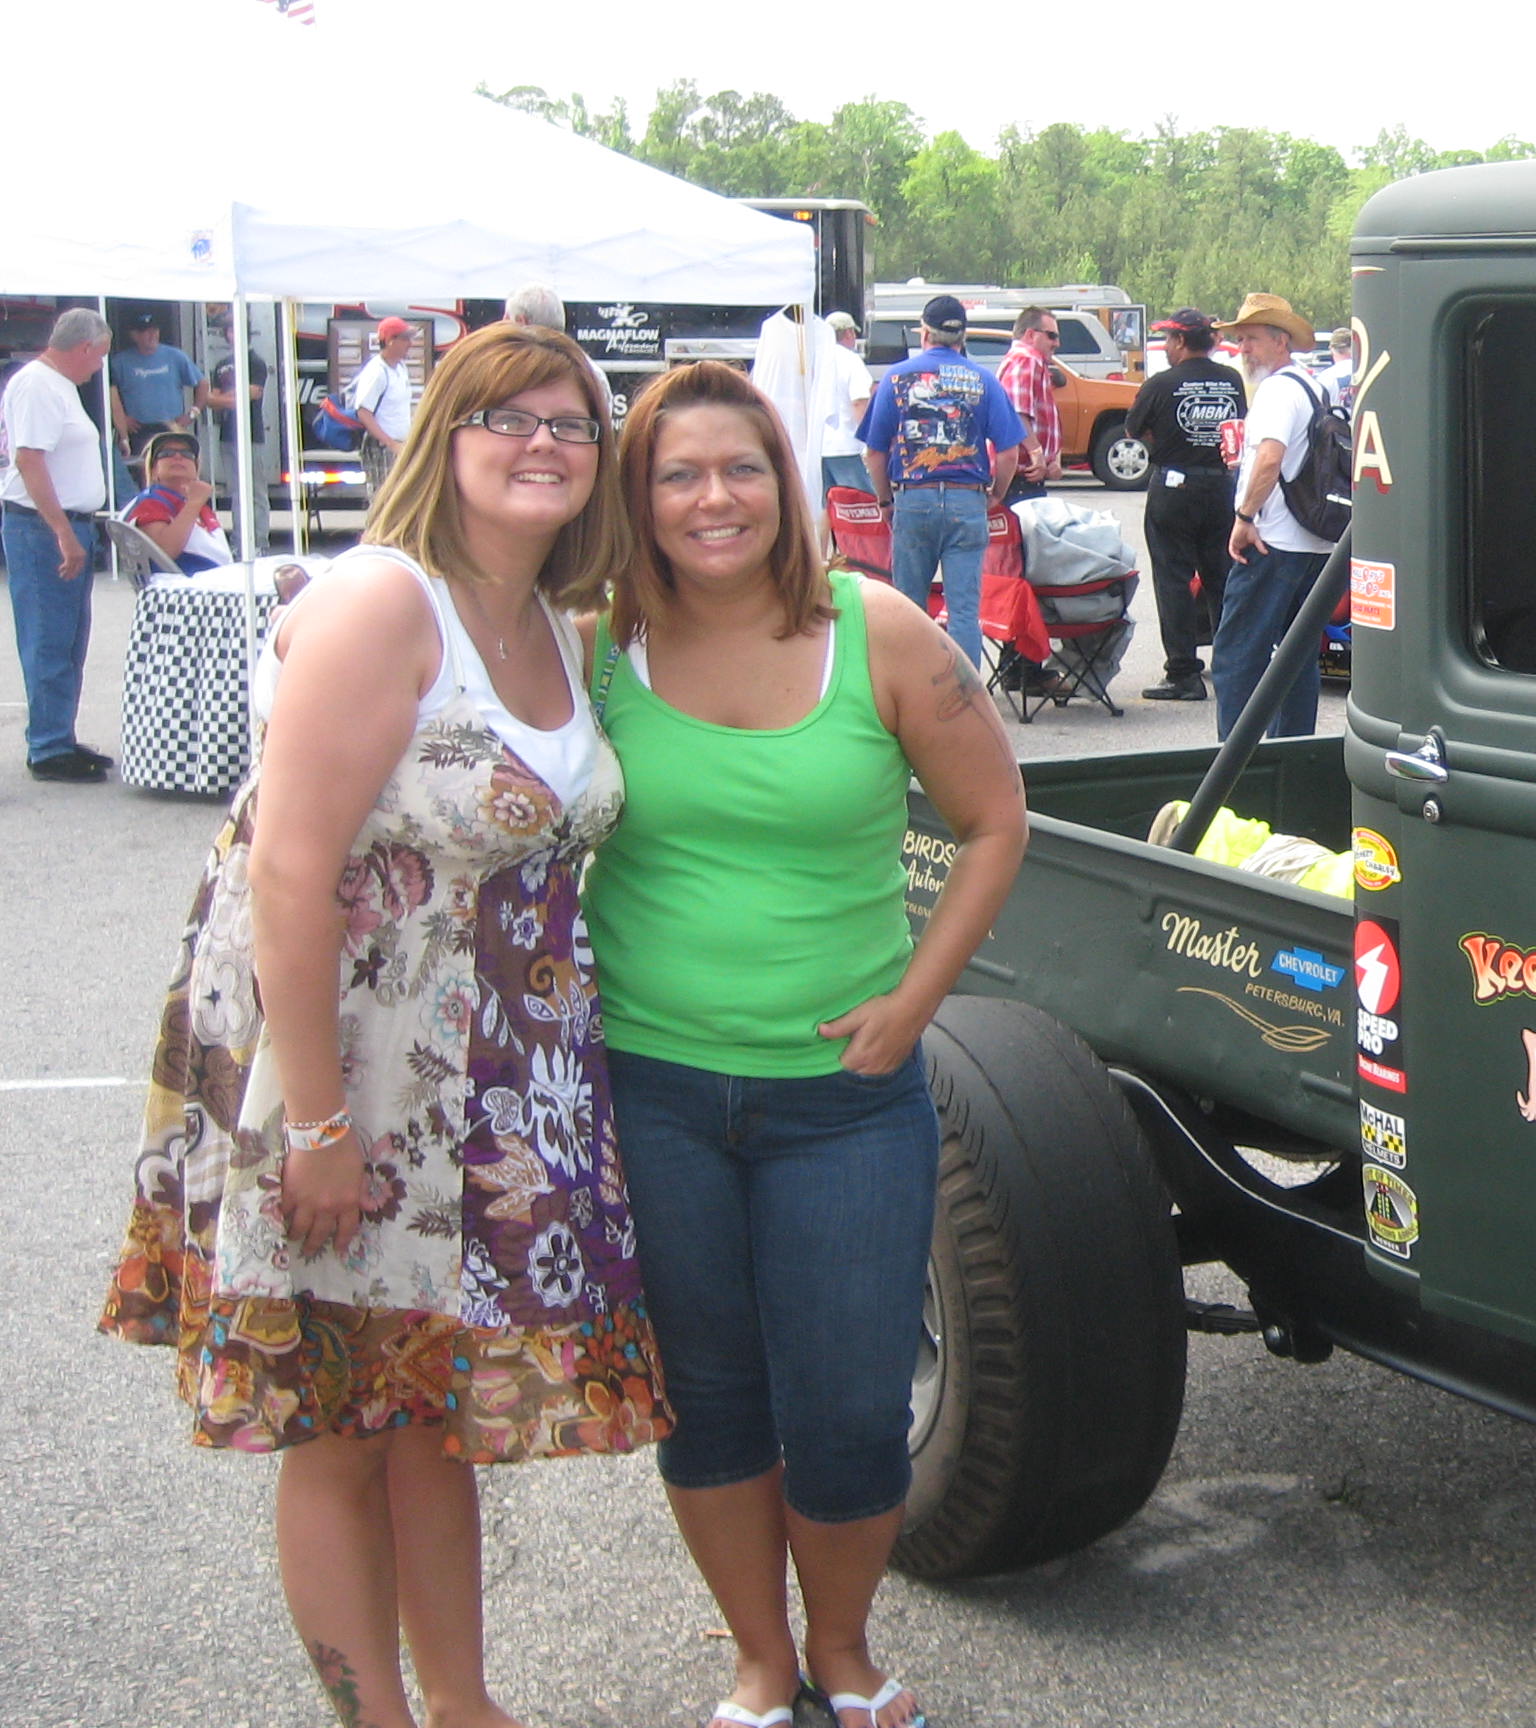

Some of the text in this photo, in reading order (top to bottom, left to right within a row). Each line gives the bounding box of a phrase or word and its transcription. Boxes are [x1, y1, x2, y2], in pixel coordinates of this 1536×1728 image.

[577, 328, 660, 341] MAGNAFLOW
[902, 830, 957, 868] BIRDS
[1161, 911, 1263, 978] Master
[1278, 952, 1338, 983] CHEVROLET
[1357, 1007, 1399, 1041] SPEED
[1357, 1026, 1384, 1056] PRO
[1360, 1102, 1403, 1137] McHAL
[1363, 1141, 1401, 1165] HELMETS
